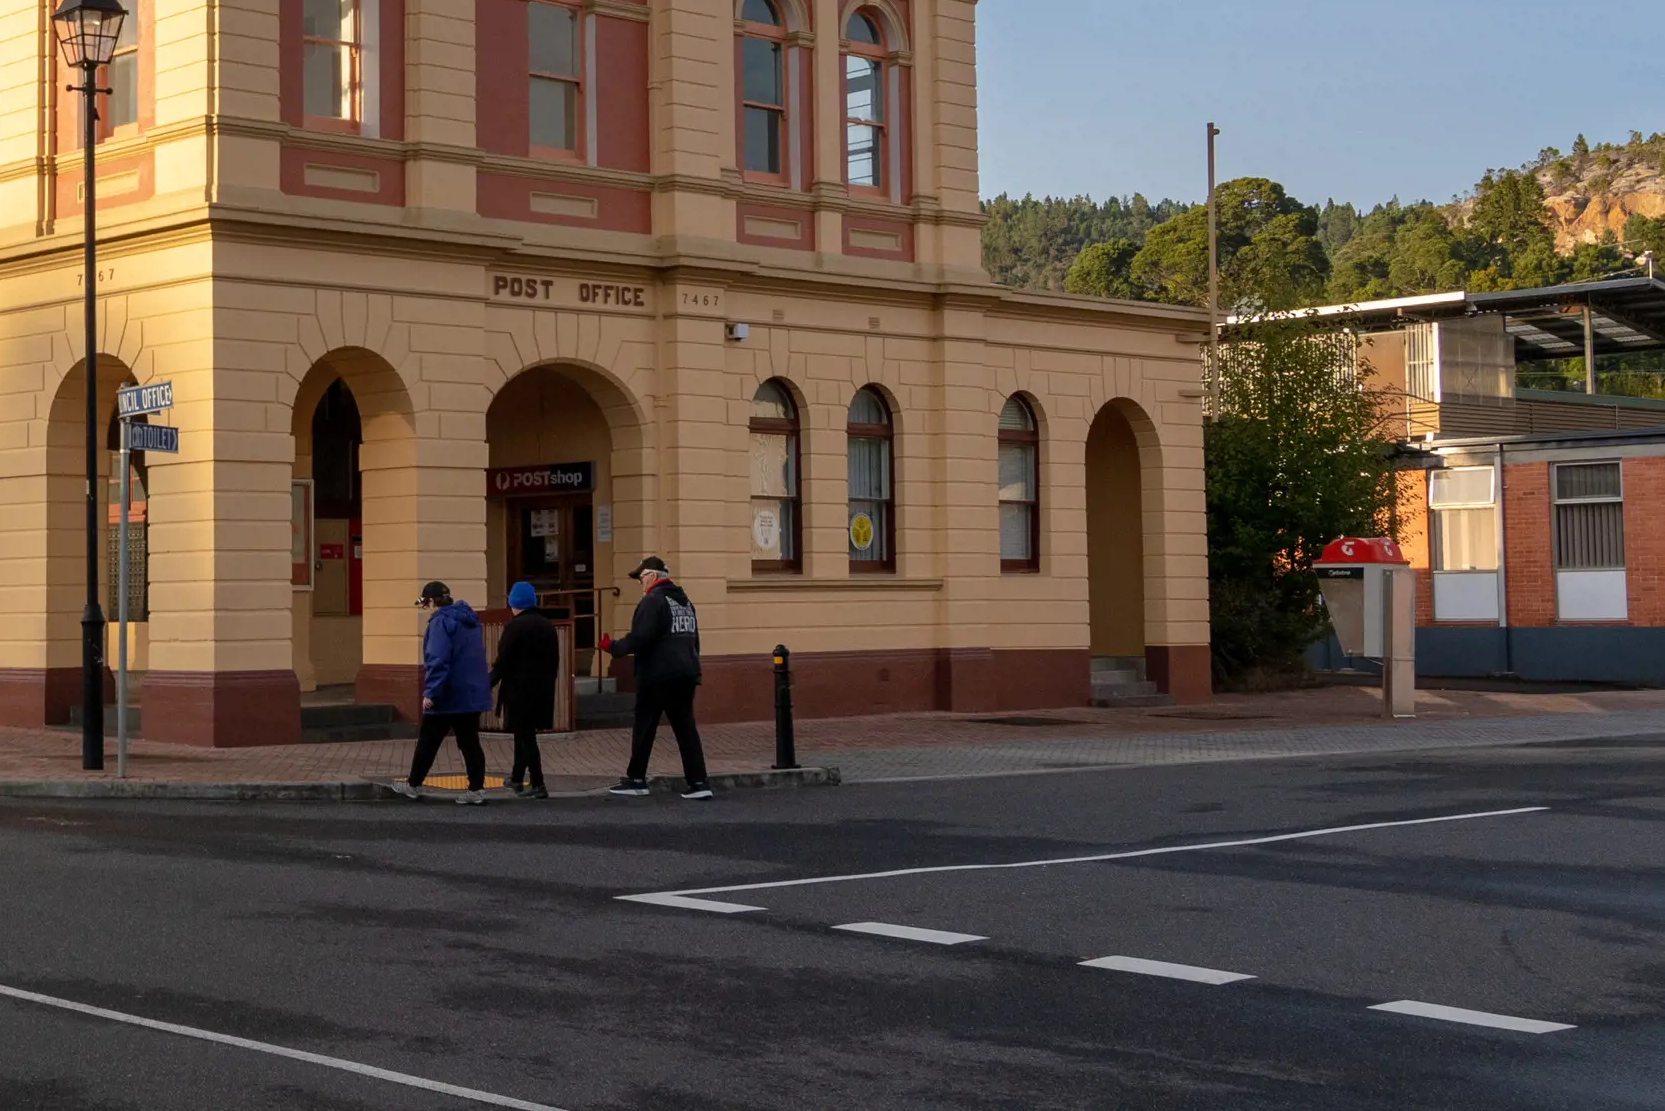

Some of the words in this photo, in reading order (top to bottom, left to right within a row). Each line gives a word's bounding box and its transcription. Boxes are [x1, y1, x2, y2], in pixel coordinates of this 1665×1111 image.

[77, 268, 115, 286] 767
[493, 275, 554, 300] POST
[579, 282, 645, 307] OFFICE
[682, 293, 719, 307] 7467
[141, 385, 171, 409] OFFICE
[142, 426, 172, 449] TOILET
[513, 470, 583, 487] POSTshop
[671, 616, 696, 633] HERO
